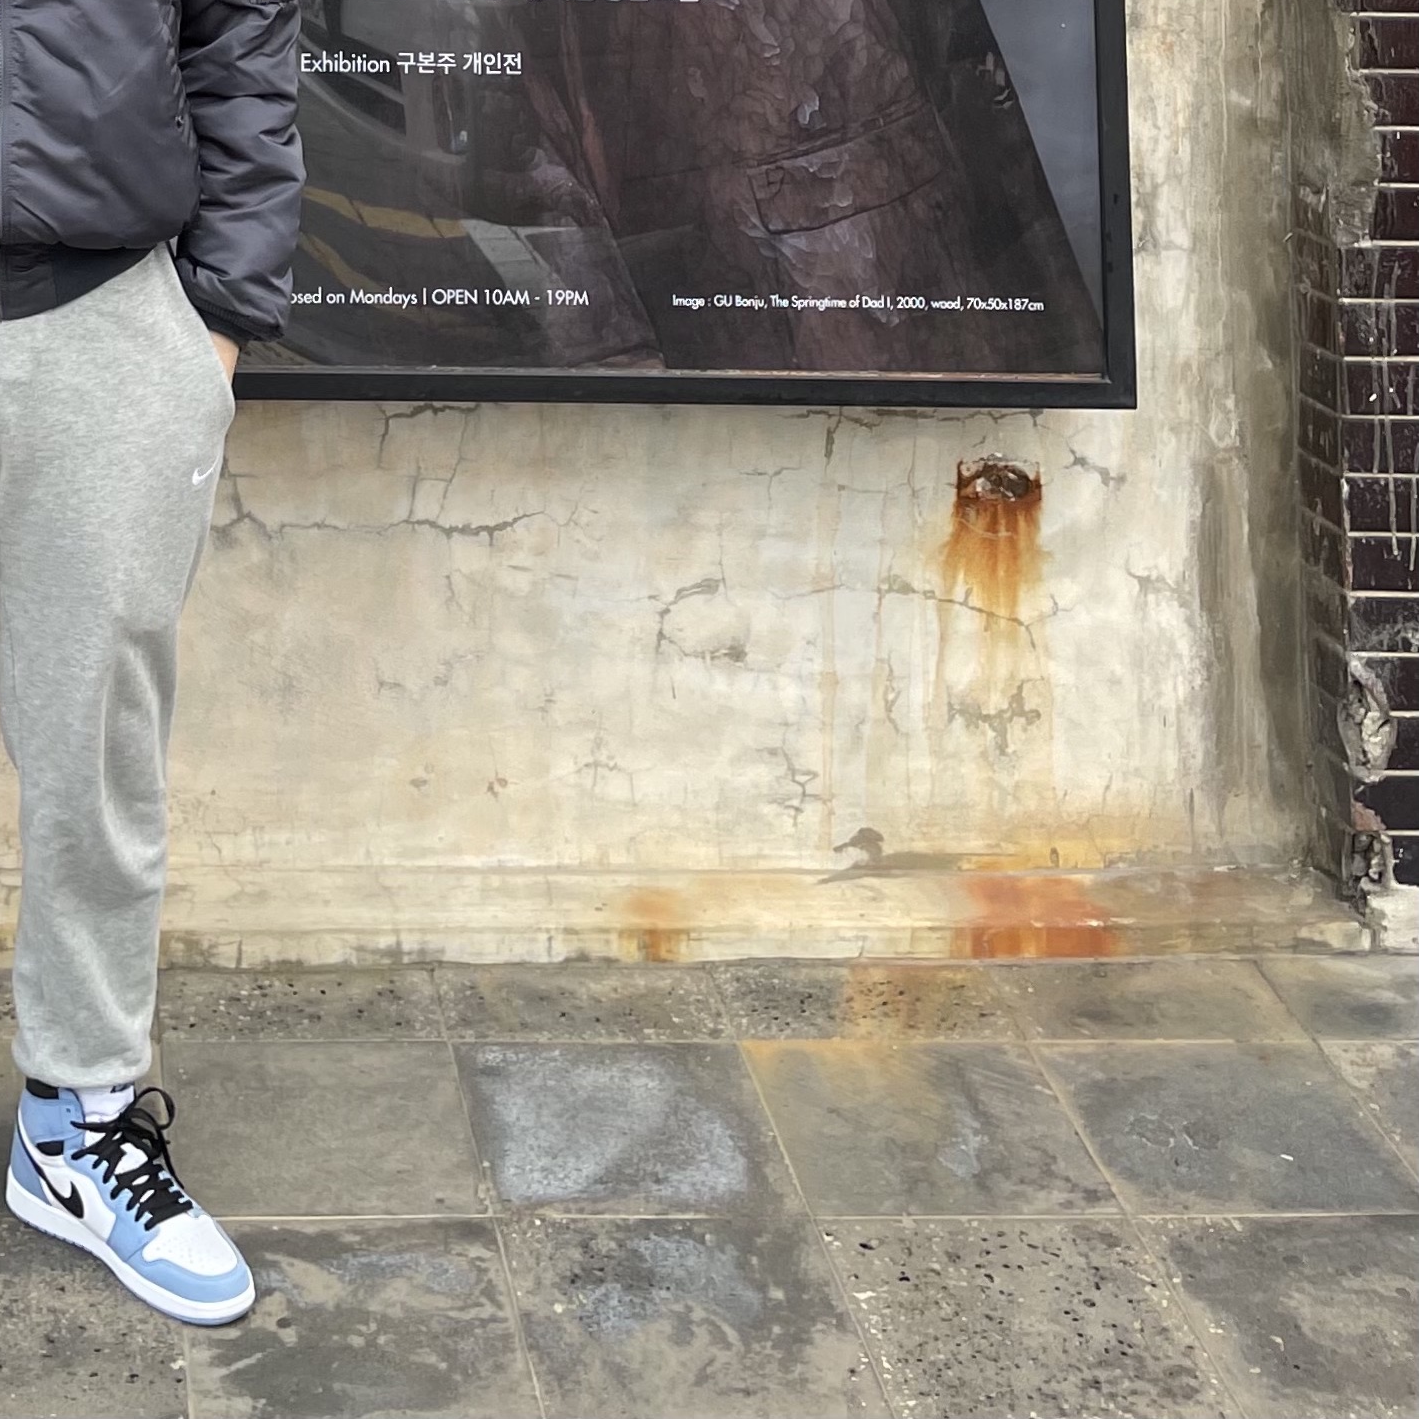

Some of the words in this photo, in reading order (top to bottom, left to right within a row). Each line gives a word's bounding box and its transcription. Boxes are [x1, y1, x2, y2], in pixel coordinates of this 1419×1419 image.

[301, 50, 390, 73] Exhibition
[397, 52, 456, 74] 구본주
[463, 52, 521, 75] 개인전
[326, 293, 345, 304] on
[350, 287, 417, 309] Mondays
[432, 289, 478, 305] OPEN
[484, 289, 530, 305] 10AM
[547, 290, 589, 305] 19PM
[673, 294, 705, 309] Image
[714, 295, 733, 308] GU
[735, 295, 767, 310] Bonju,
[770, 294, 789, 307] The
[791, 295, 847, 311] Springtime
[849, 295, 860, 308] of
[862, 295, 884, 309] Dad
[896, 296, 928, 311] 2000,
[930, 296, 963, 311] wood,
[967, 297, 1044, 312] 70x50x187cm
